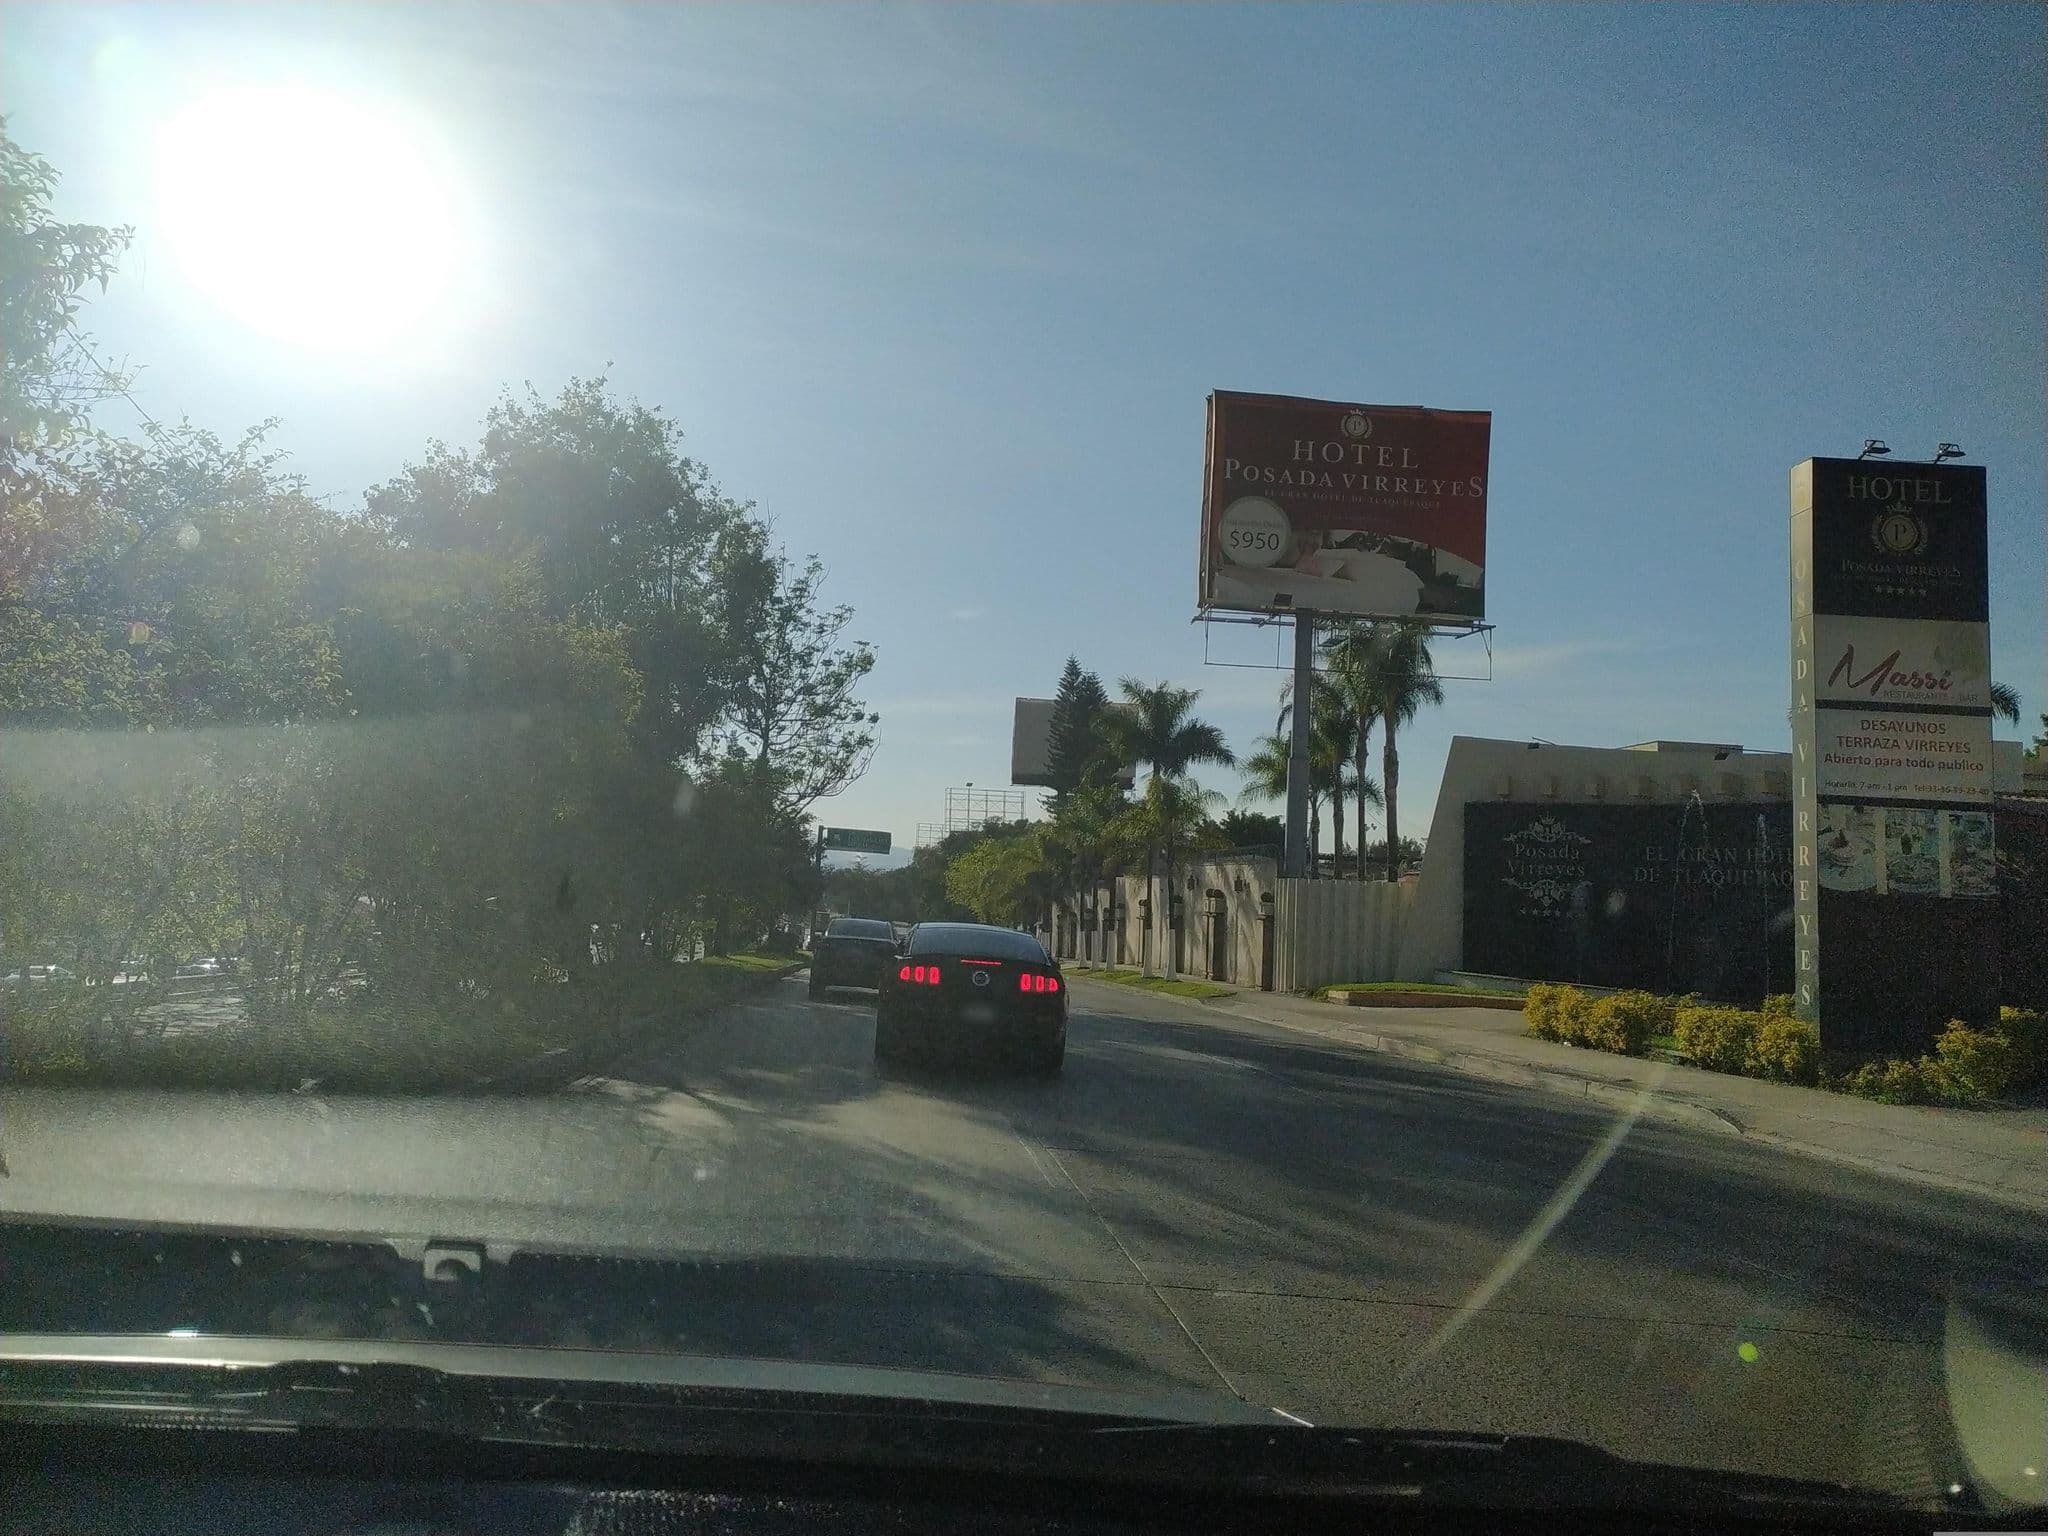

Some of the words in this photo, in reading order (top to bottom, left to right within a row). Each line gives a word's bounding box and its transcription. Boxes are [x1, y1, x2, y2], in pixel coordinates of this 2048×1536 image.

[1292, 439, 1420, 470] HOTEL
[1224, 458, 1336, 489] POSADA
[1342, 473, 1484, 498] VIRREYES
[1848, 476, 1952, 504] HOTEL
[1229, 530, 1280, 551] $950
[1827, 643, 1953, 696] Massi
[1861, 719, 1947, 735] DESAYUNOS
[1836, 735, 1900, 751] TERRAZA
[1904, 738, 1972, 754] VIRREYES
[1824, 753, 1872, 766] Abierto
[1875, 757, 1902, 770] para
[1905, 757, 1934, 769] todo
[1513, 842, 1580, 861] Posada
[1646, 848, 1668, 863] EL
